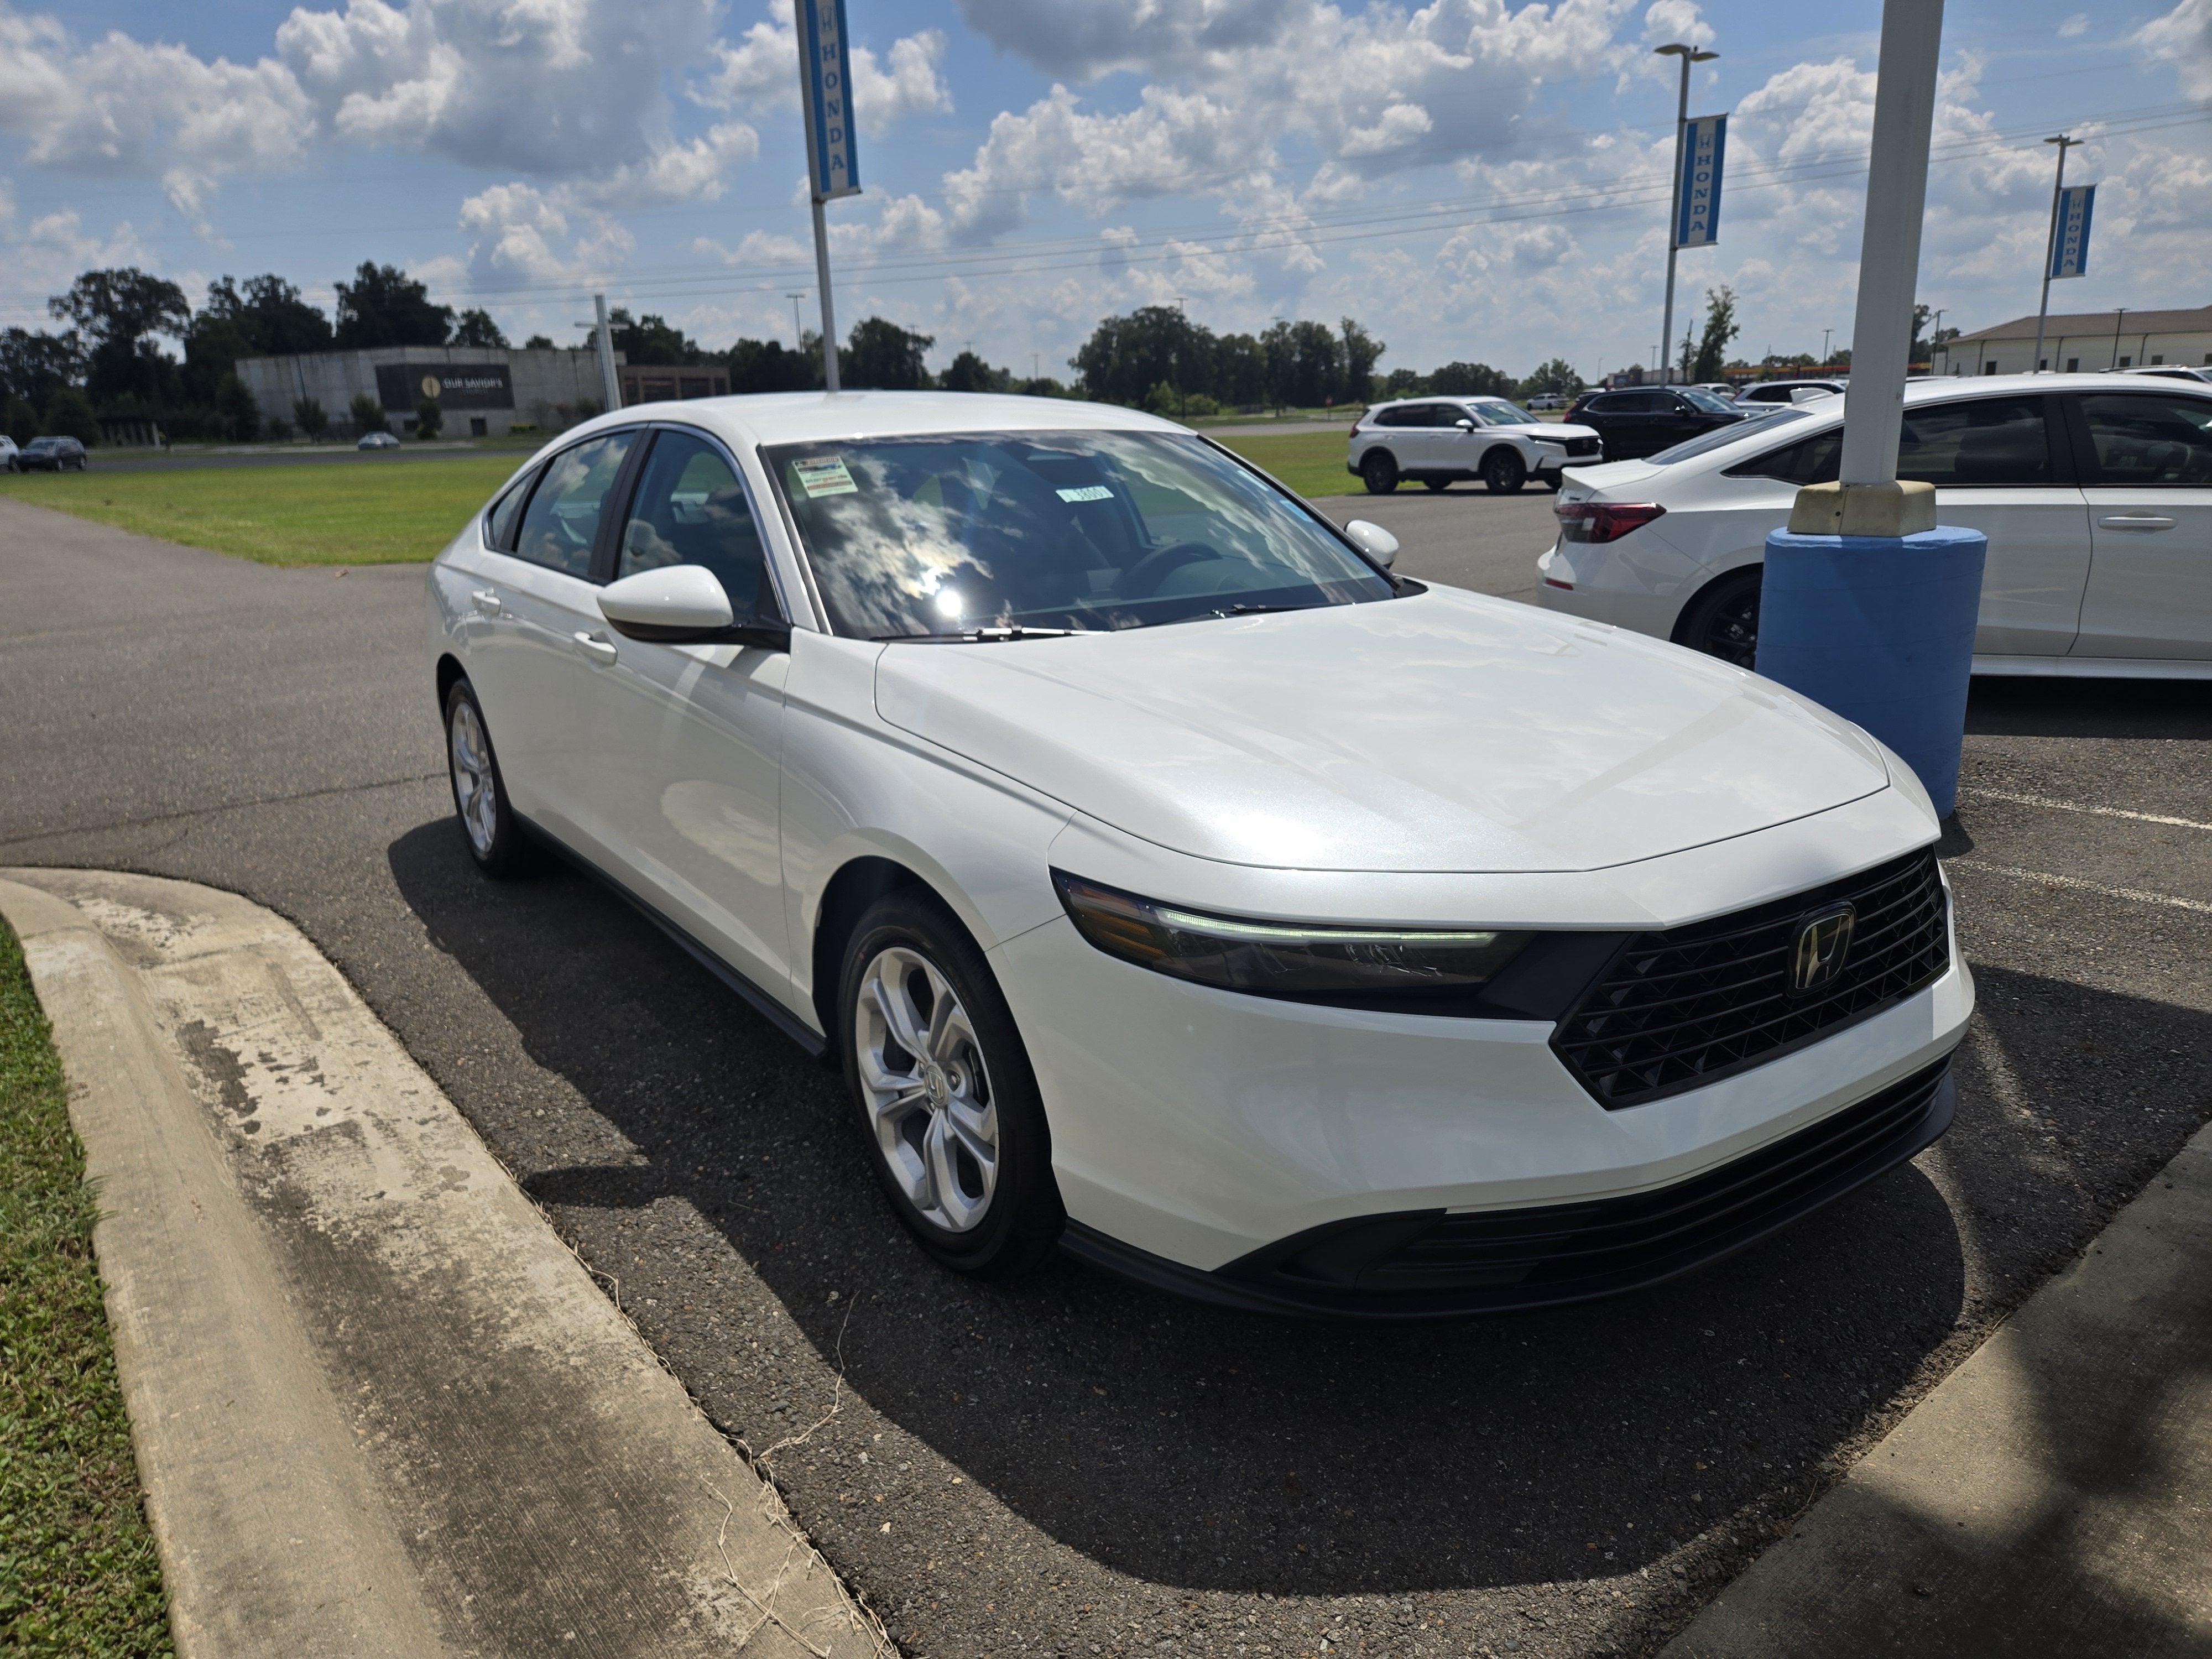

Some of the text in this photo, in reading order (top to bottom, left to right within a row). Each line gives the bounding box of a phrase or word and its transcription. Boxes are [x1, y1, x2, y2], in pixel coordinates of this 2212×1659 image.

[822, 43, 844, 170] HONDA
[1691, 155, 1712, 232] HONDA
[2063, 213, 2081, 267] HONDA
